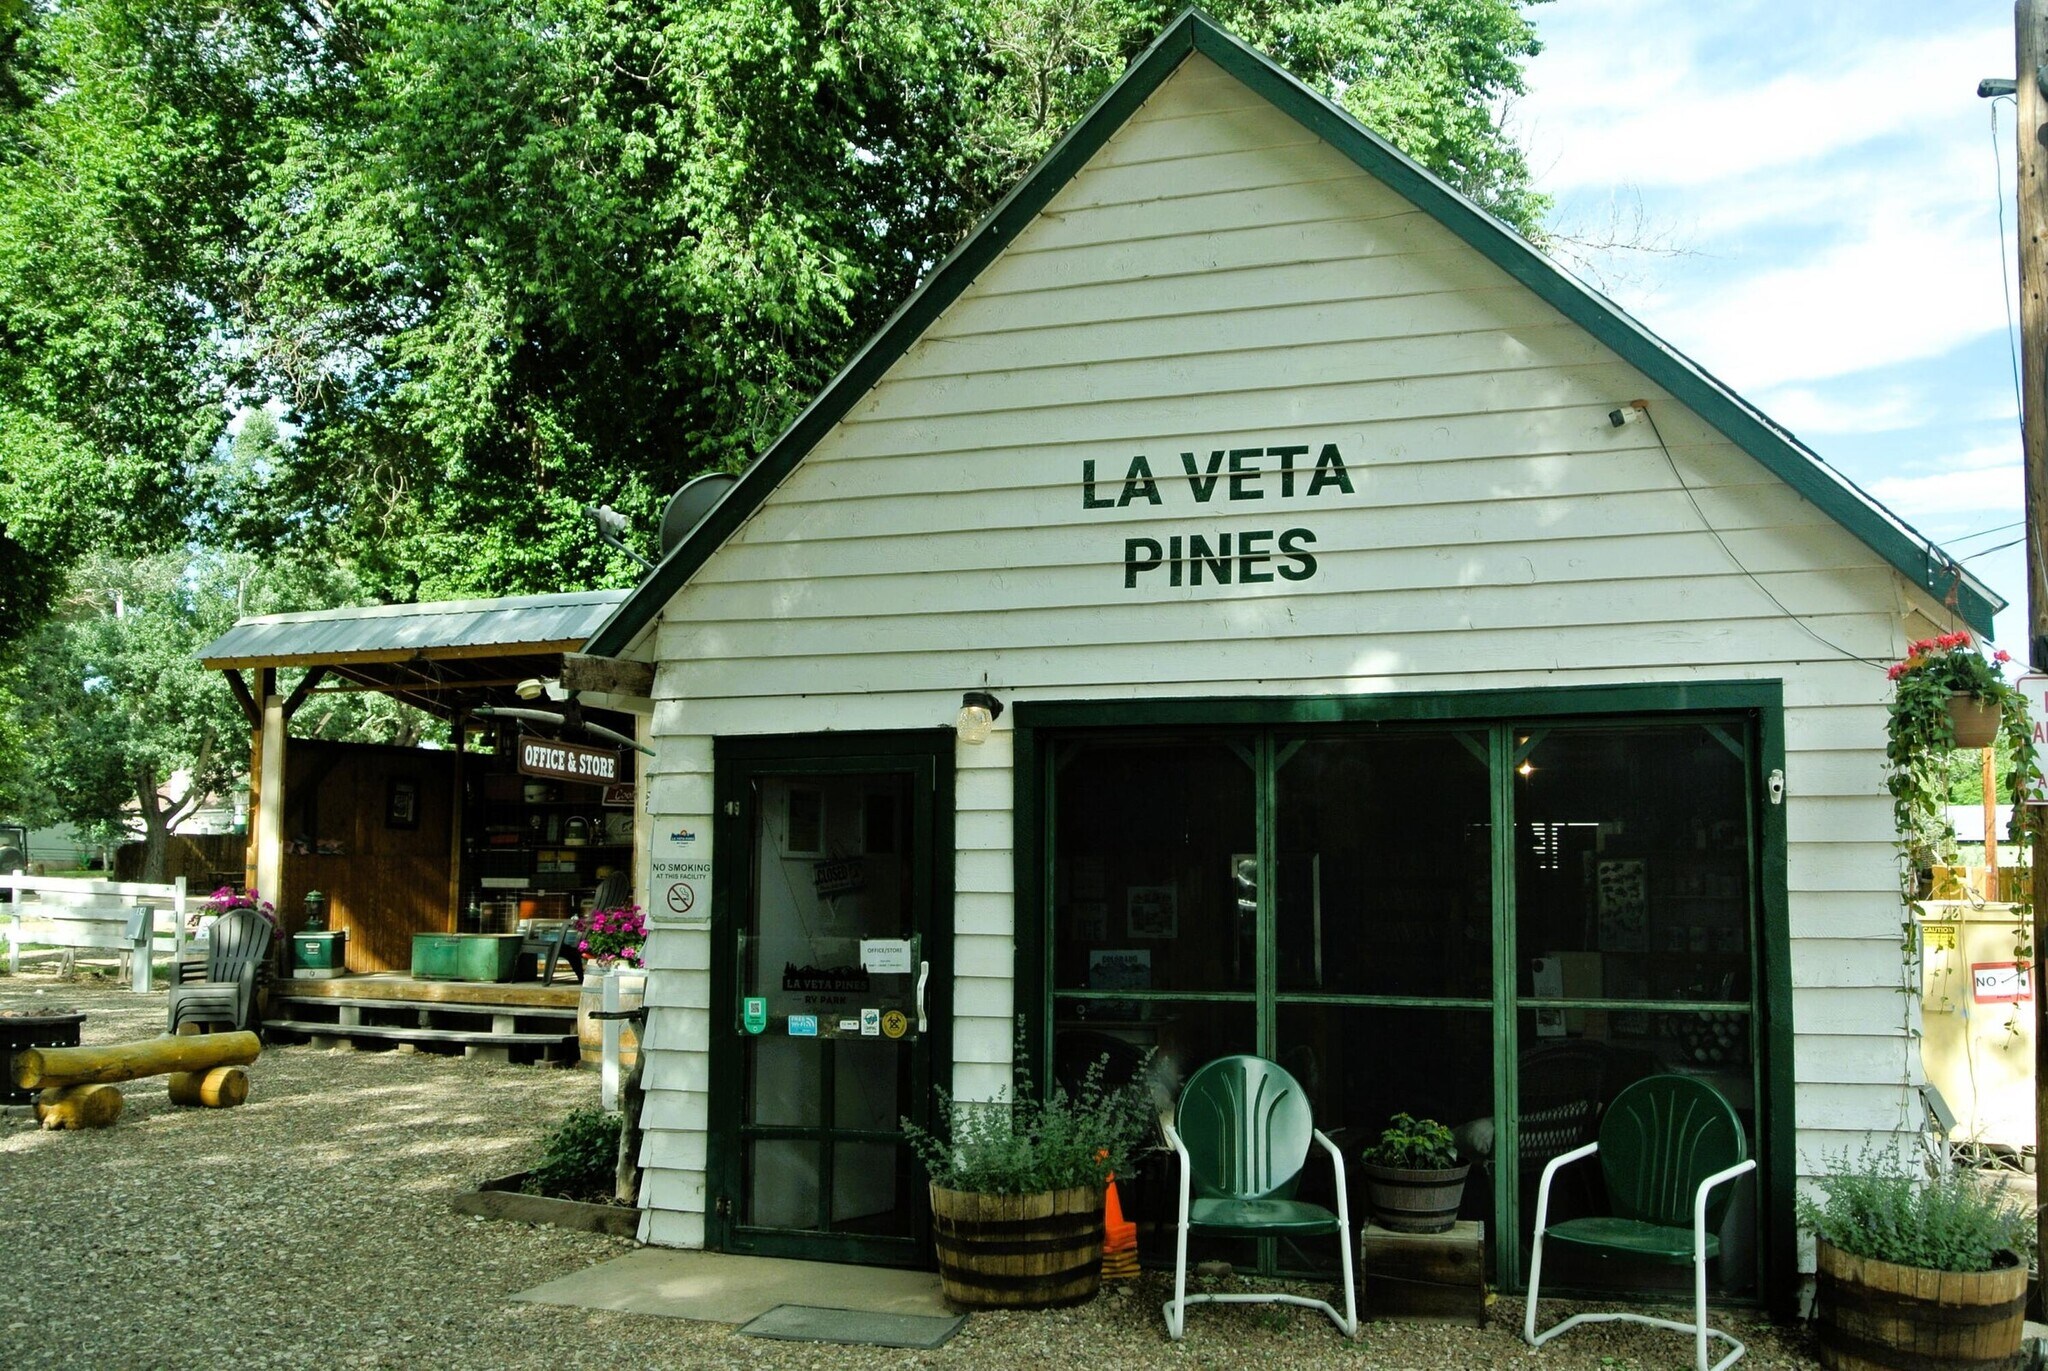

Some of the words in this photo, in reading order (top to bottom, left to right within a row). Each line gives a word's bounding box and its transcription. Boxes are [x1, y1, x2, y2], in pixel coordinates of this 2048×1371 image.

[1083, 455, 1163, 509] LA
[1180, 443, 1355, 503] VETA
[1124, 528, 1318, 589] PINES
[2033, 722, 2048, 744] A
[525, 744, 566, 771] OFFICE
[567, 752, 577, 773] &
[579, 754, 615, 779] STORE
[652, 863, 666, 872] NO
[668, 863, 711, 872] SMOKING
[786, 979, 800, 989] LA
[803, 979, 833, 990] VETA
[835, 979, 868, 991] PINES
[1976, 976, 1997, 987] NO
[805, 996, 817, 1004] RV
[820, 996, 847, 1004] PARK
